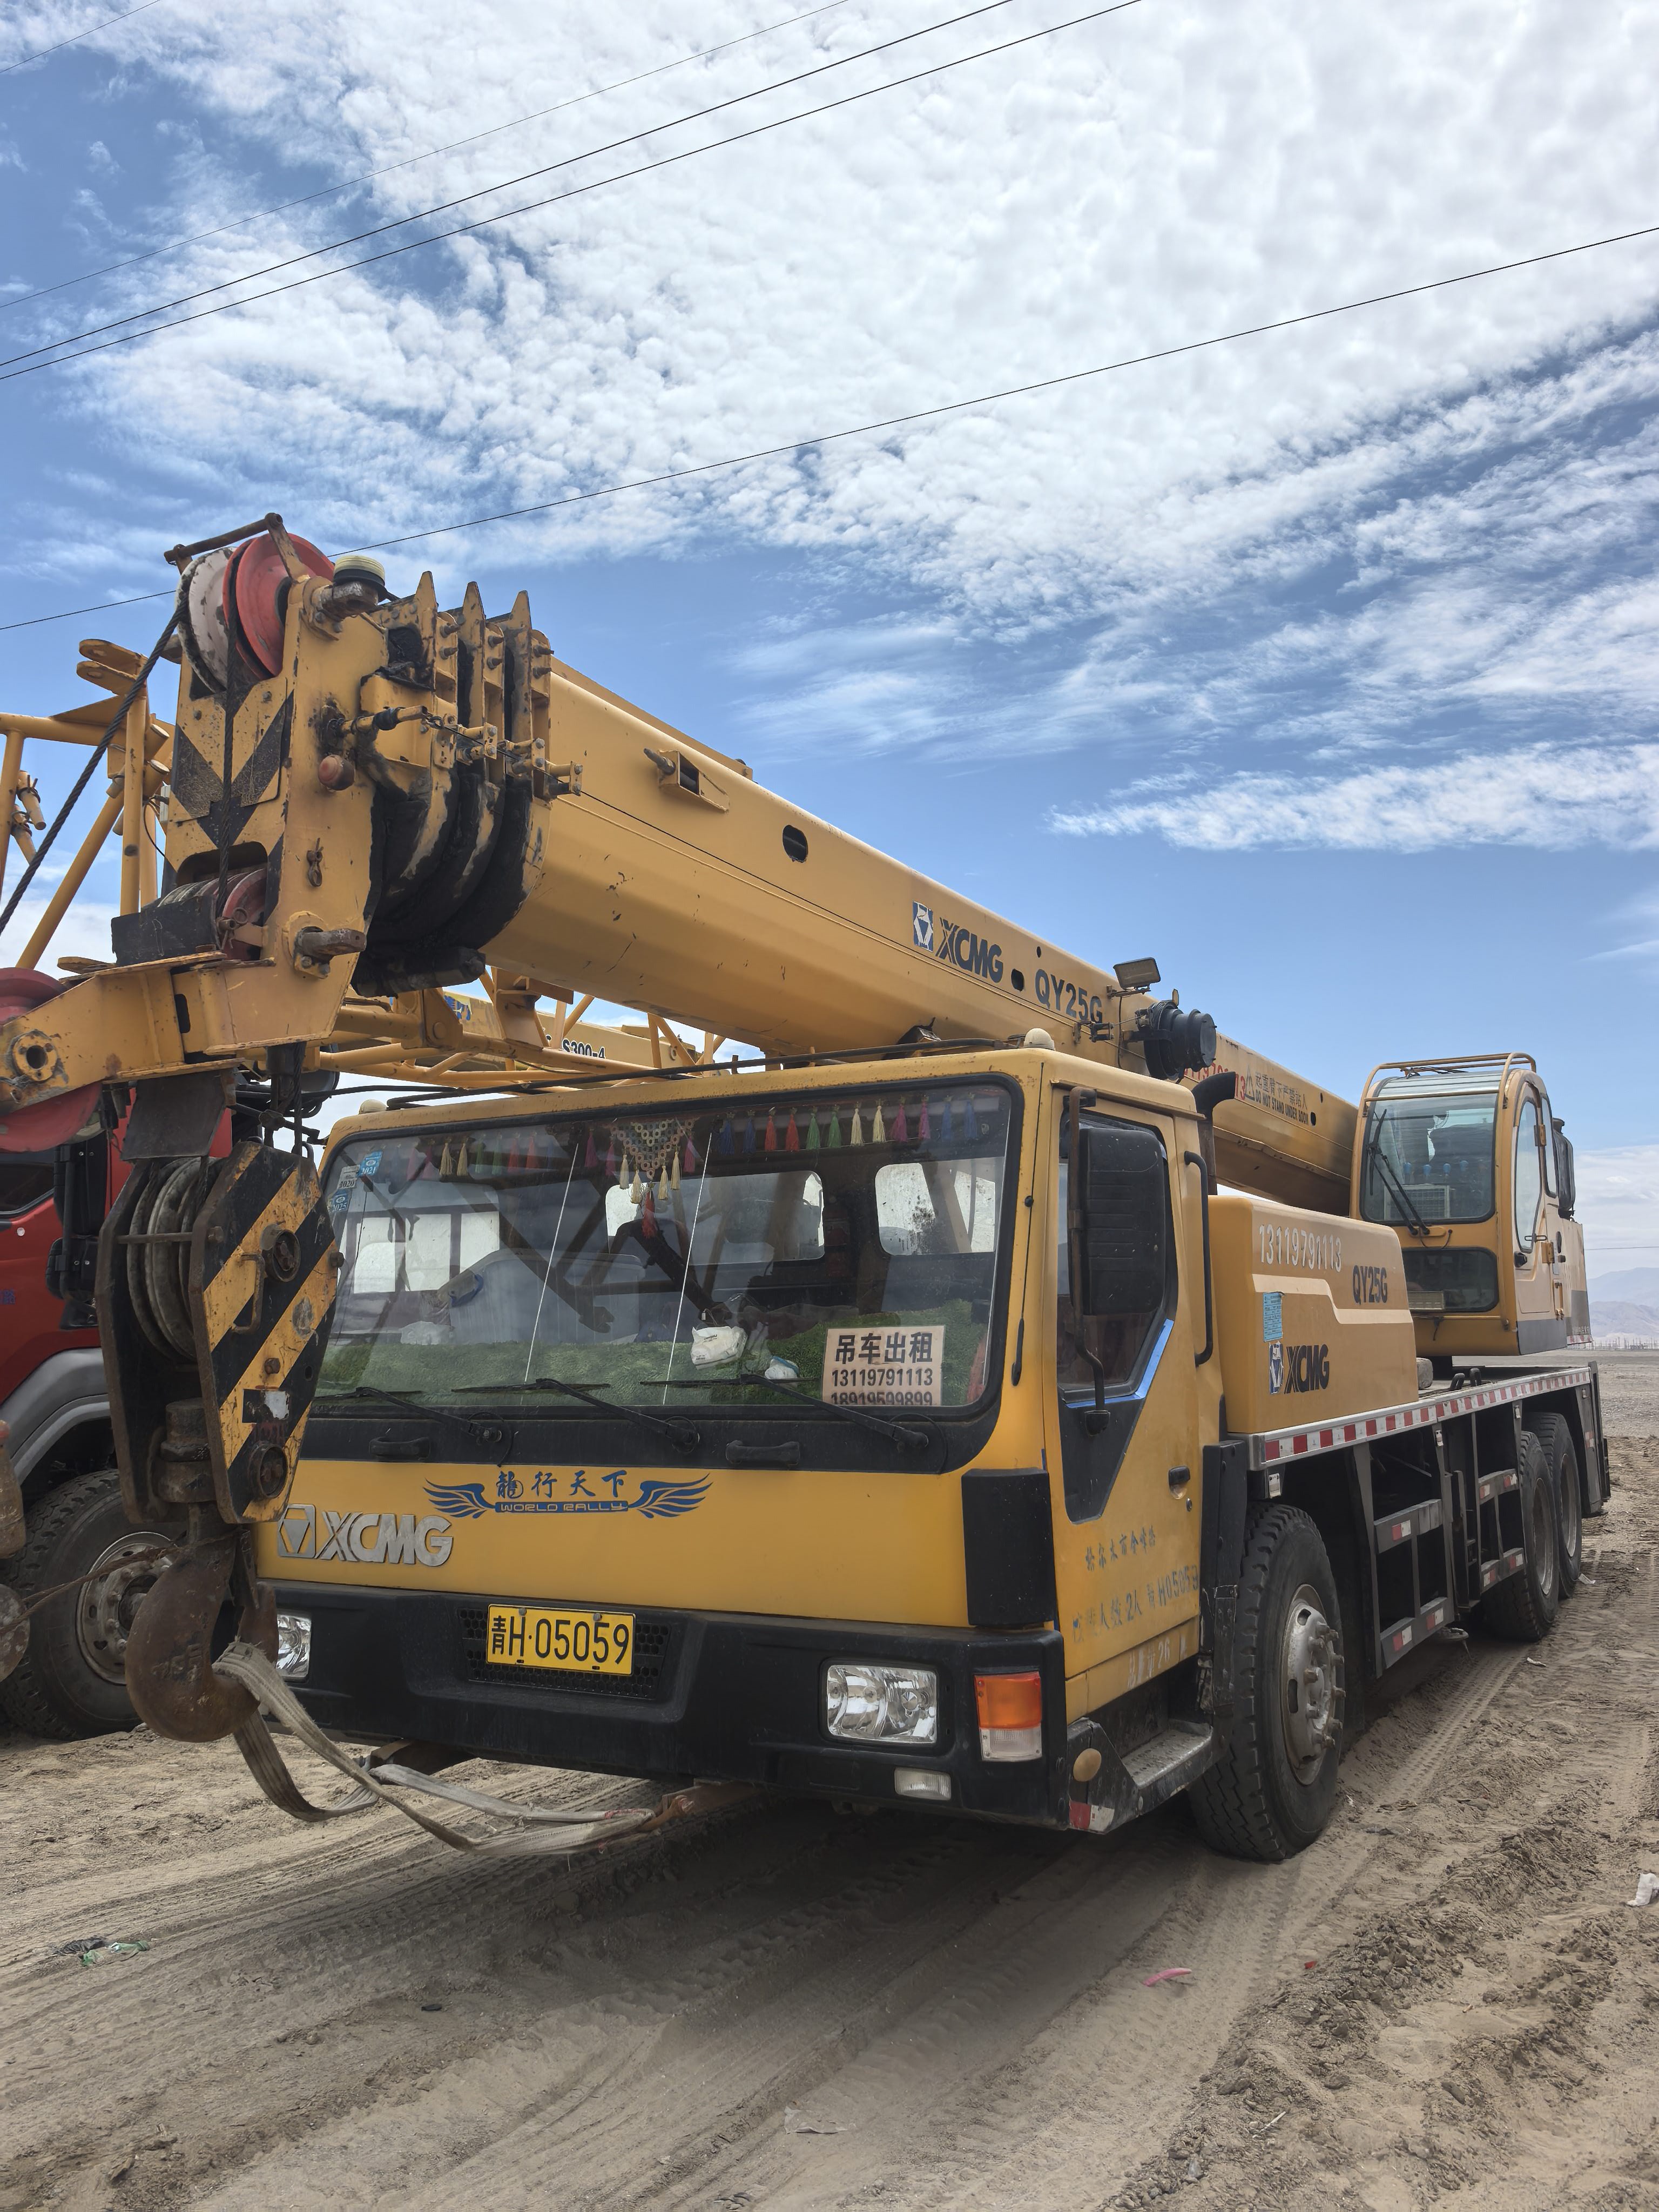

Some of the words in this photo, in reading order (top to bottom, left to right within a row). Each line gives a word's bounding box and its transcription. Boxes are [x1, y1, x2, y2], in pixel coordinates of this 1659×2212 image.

[935, 917, 1003, 983] XCMG
[1035, 969, 1103, 1024] QY25G
[1259, 1224, 1341, 1272] 13119791113
[1352, 1264, 1388, 1304] QY25G
[835, 1332, 933, 1365] 吊车出租
[1284, 1344, 1330, 1394] XCMG
[832, 1368, 933, 1387] 13119791113
[500, 1503, 558, 1512] WORLD
[563, 1502, 626, 1512] RALLY
[318, 1512, 454, 1568] XCMG
